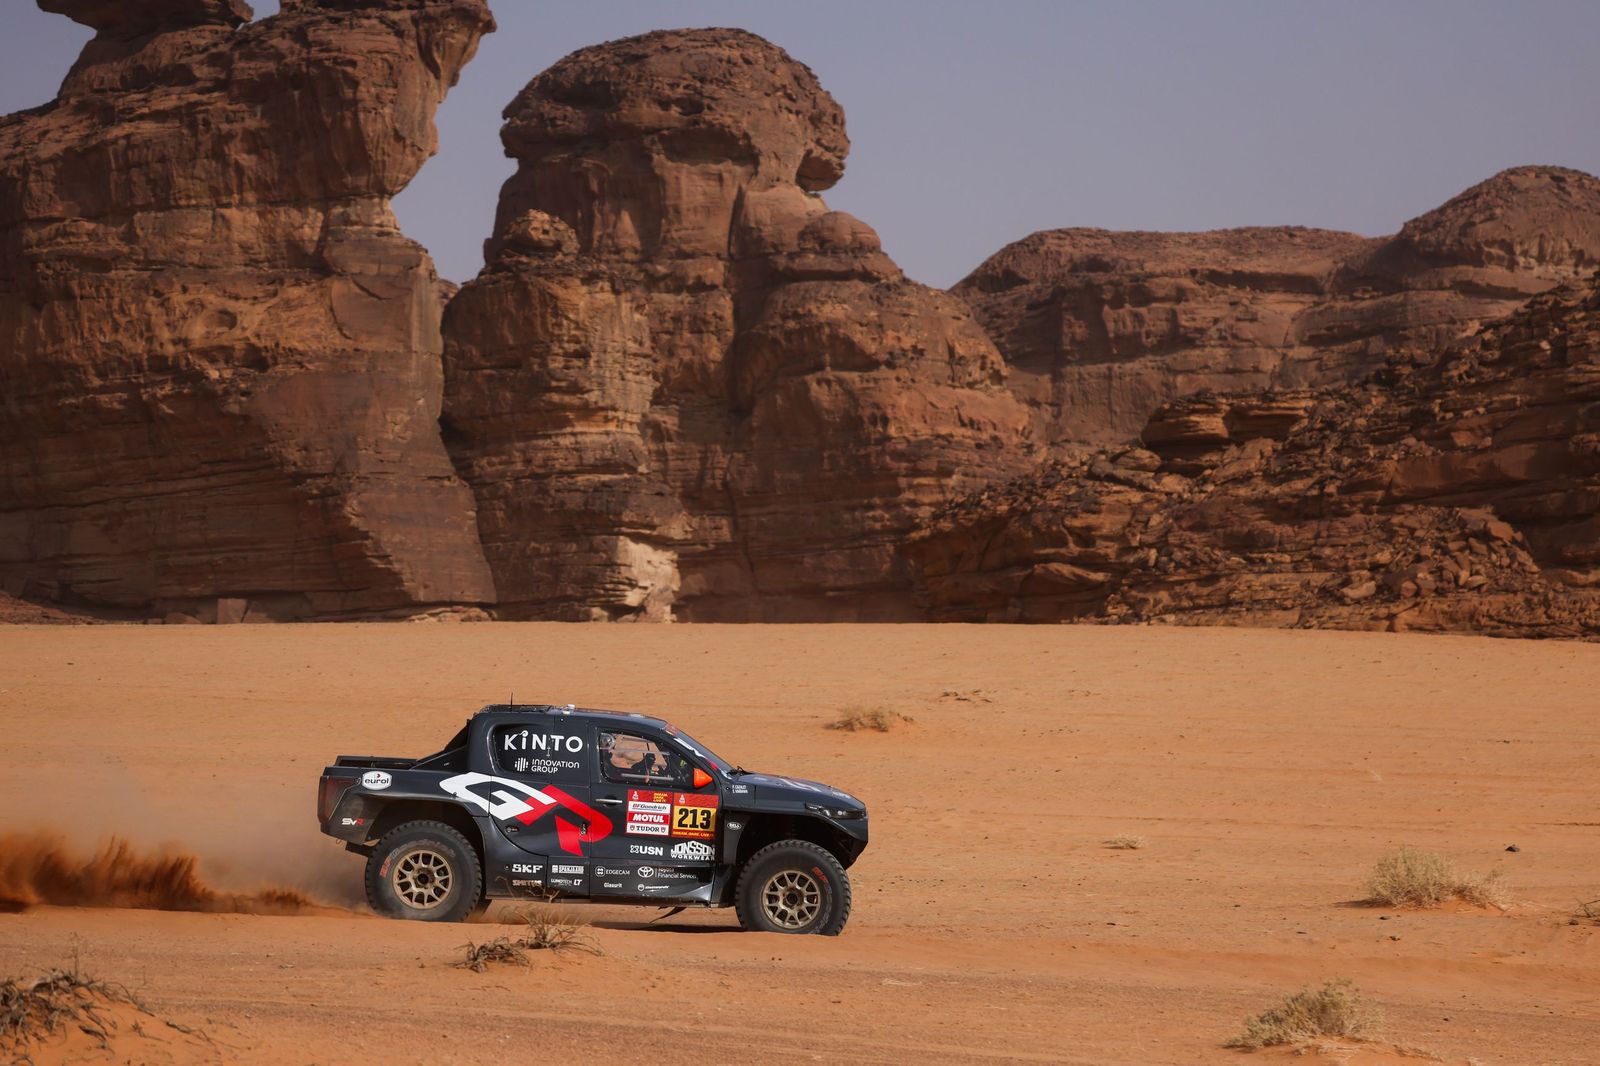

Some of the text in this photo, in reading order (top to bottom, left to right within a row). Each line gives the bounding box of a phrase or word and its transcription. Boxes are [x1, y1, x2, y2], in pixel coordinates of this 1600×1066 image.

[531, 758, 580, 769] INNOVATION
[531, 765, 558, 774] GROUP
[633, 813, 664, 823] MOTUL
[677, 808, 712, 830] 213
[636, 825, 660, 833] TUDOR
[639, 845, 664, 856] USN
[670, 840, 716, 856] JONSSON
[670, 853, 716, 861] WORKWEAR
[512, 864, 543, 874] SKF
[573, 878, 583, 886] LT
